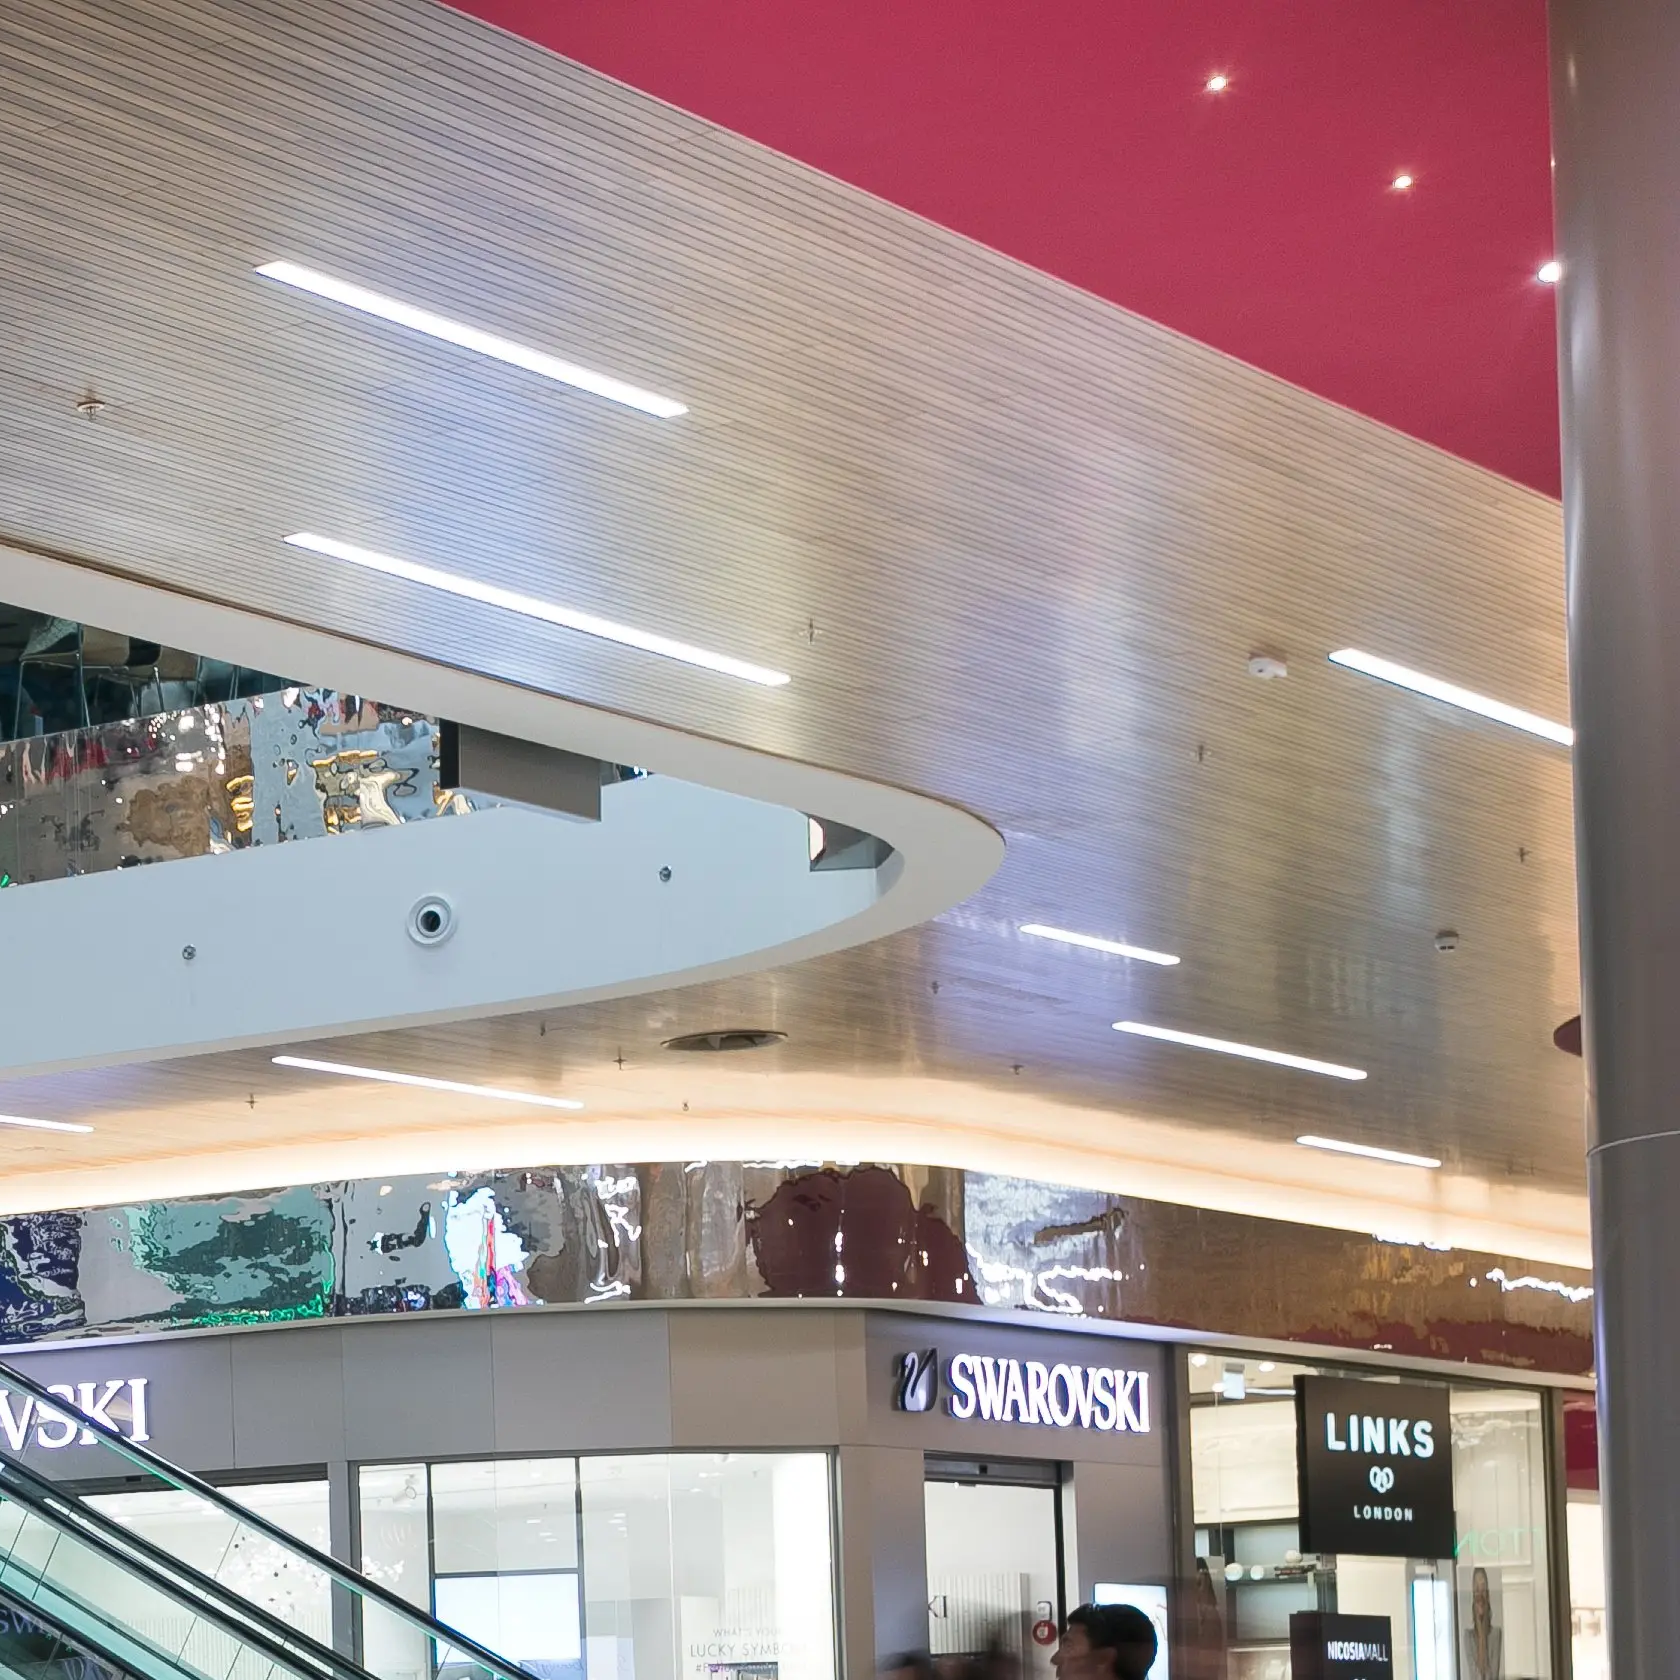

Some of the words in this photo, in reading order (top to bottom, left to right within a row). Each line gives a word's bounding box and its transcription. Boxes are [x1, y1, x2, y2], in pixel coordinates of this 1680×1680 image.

[949, 1353, 1151, 1433] SWAROVSKI
[1326, 1412, 1435, 1458] LINKS
[1353, 1505, 1413, 1521] LONDON
[690, 1643, 736, 1657] LUCKY
